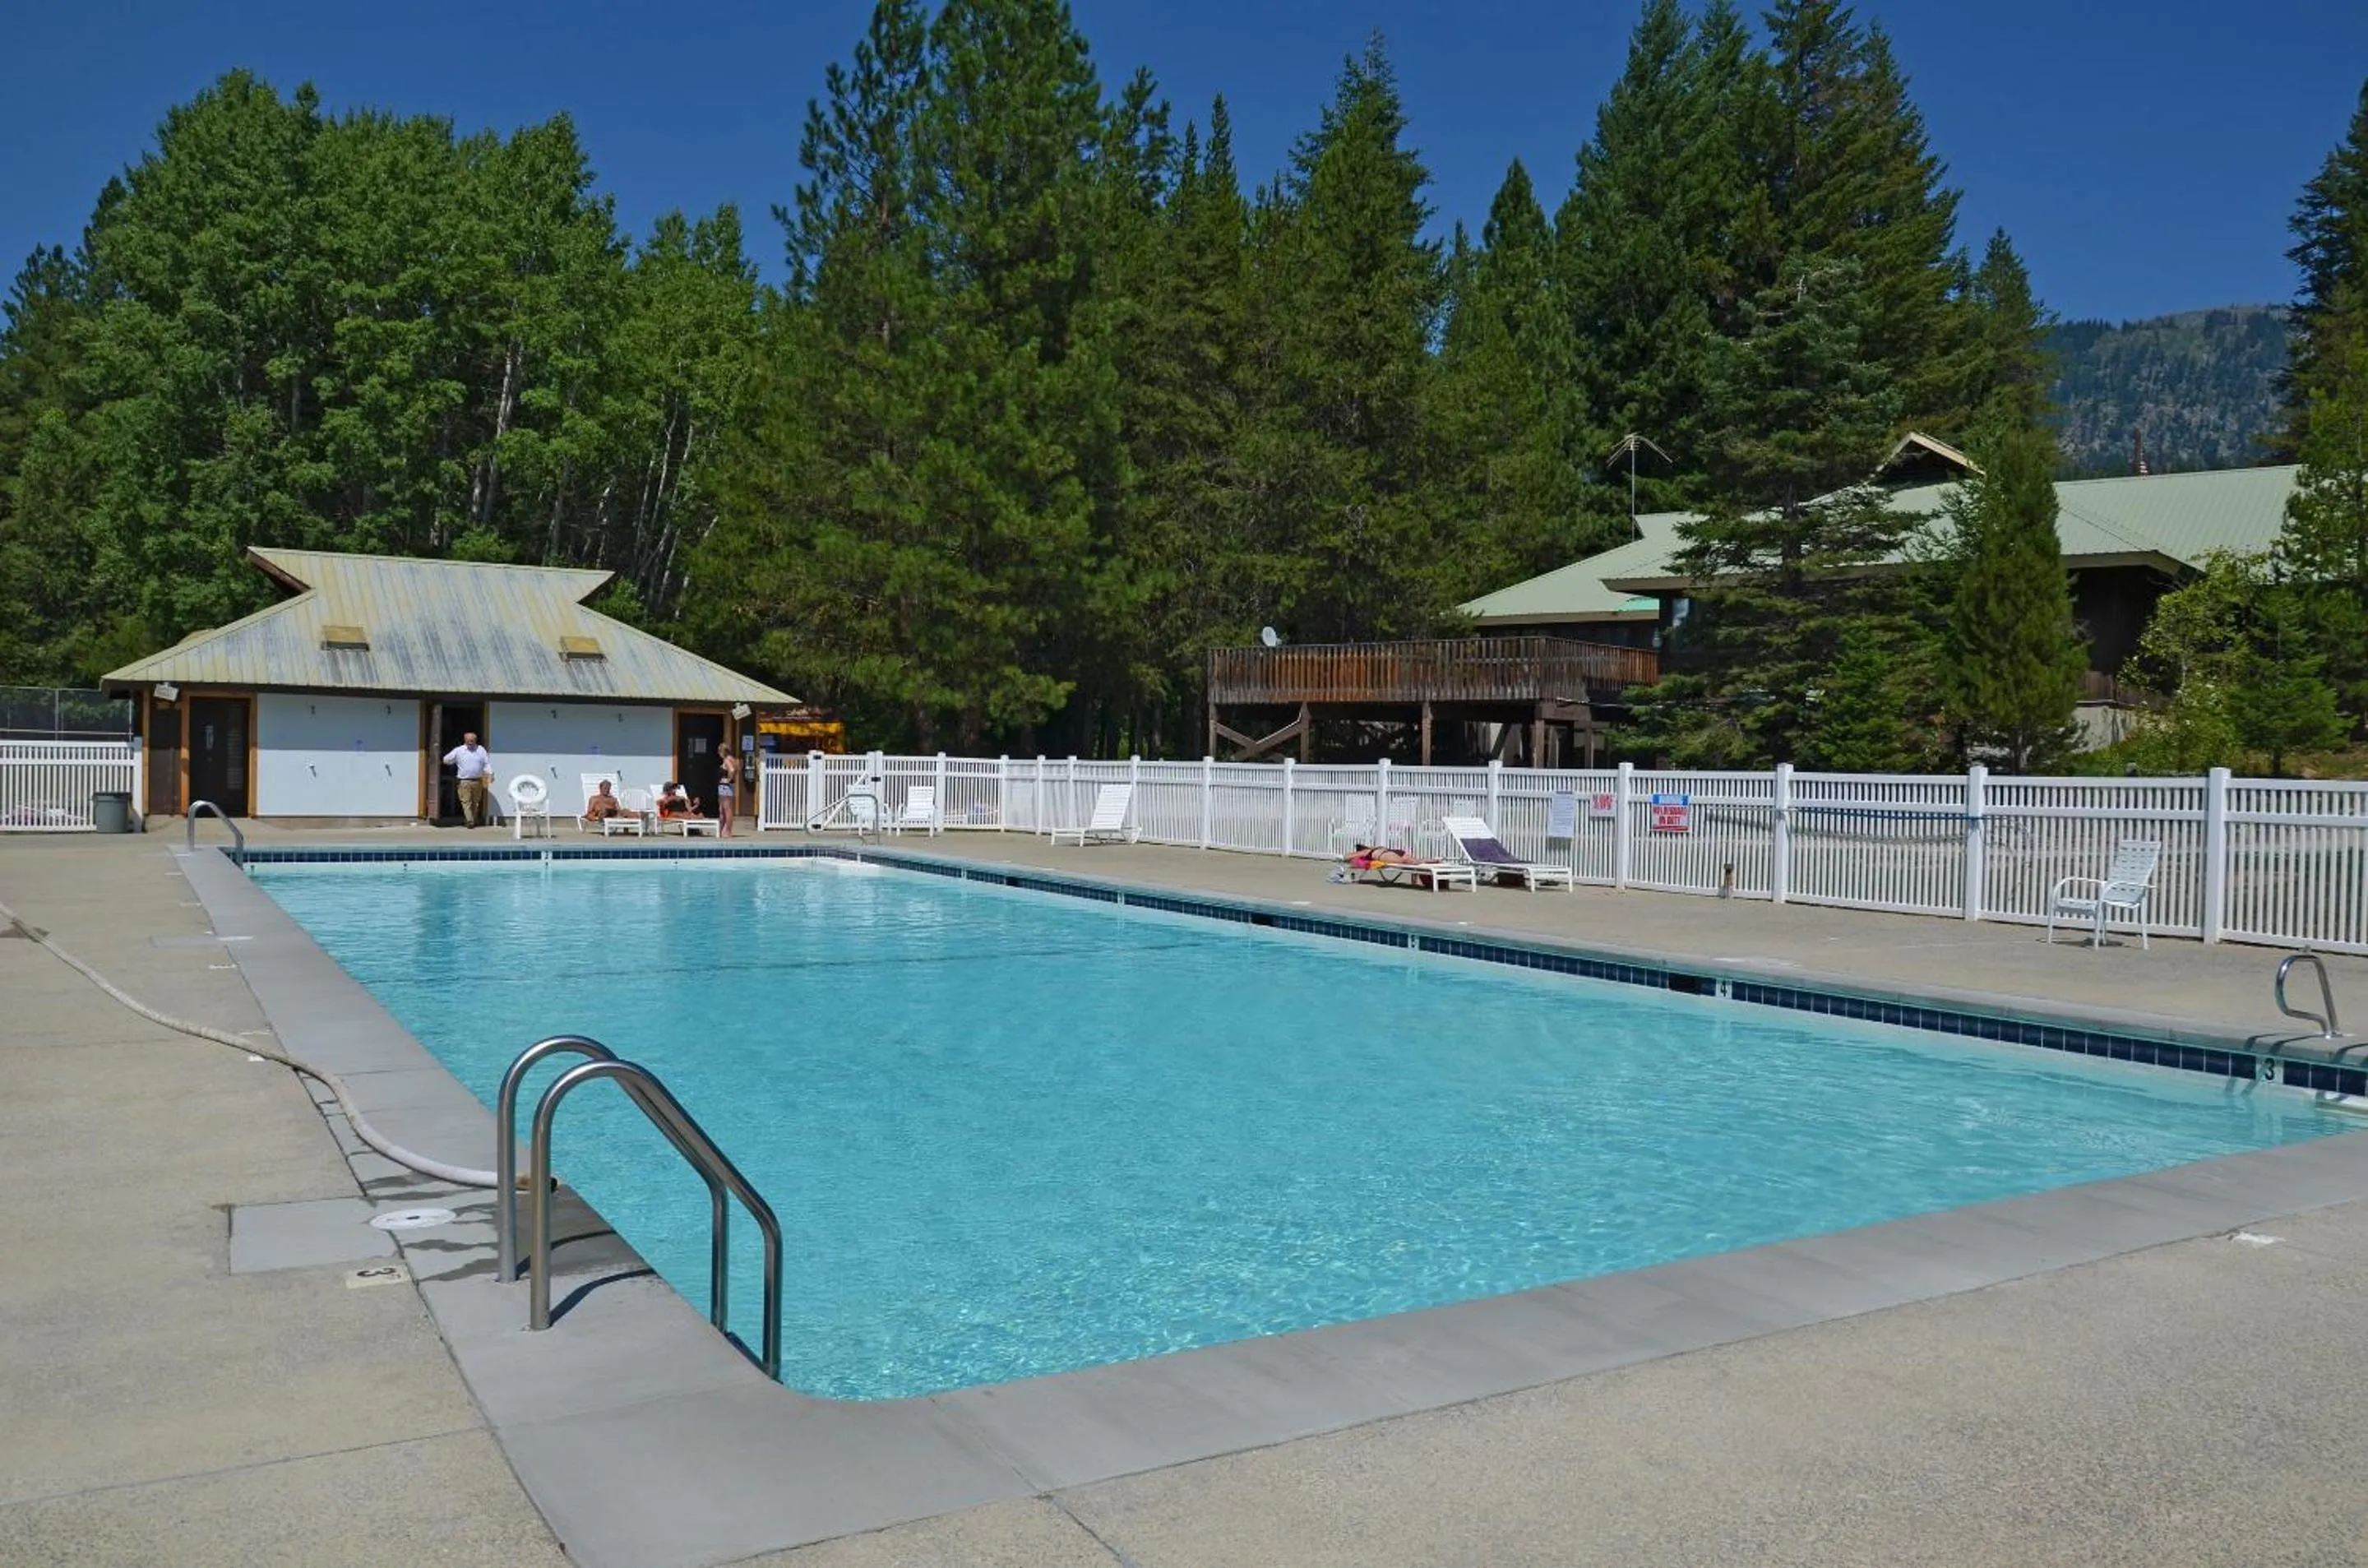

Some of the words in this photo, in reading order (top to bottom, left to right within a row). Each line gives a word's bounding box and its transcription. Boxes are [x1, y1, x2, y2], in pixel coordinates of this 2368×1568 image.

[1720, 979, 1727, 997] 4
[2265, 1057, 2275, 1080] 3
[356, 1267, 396, 1278] 3
